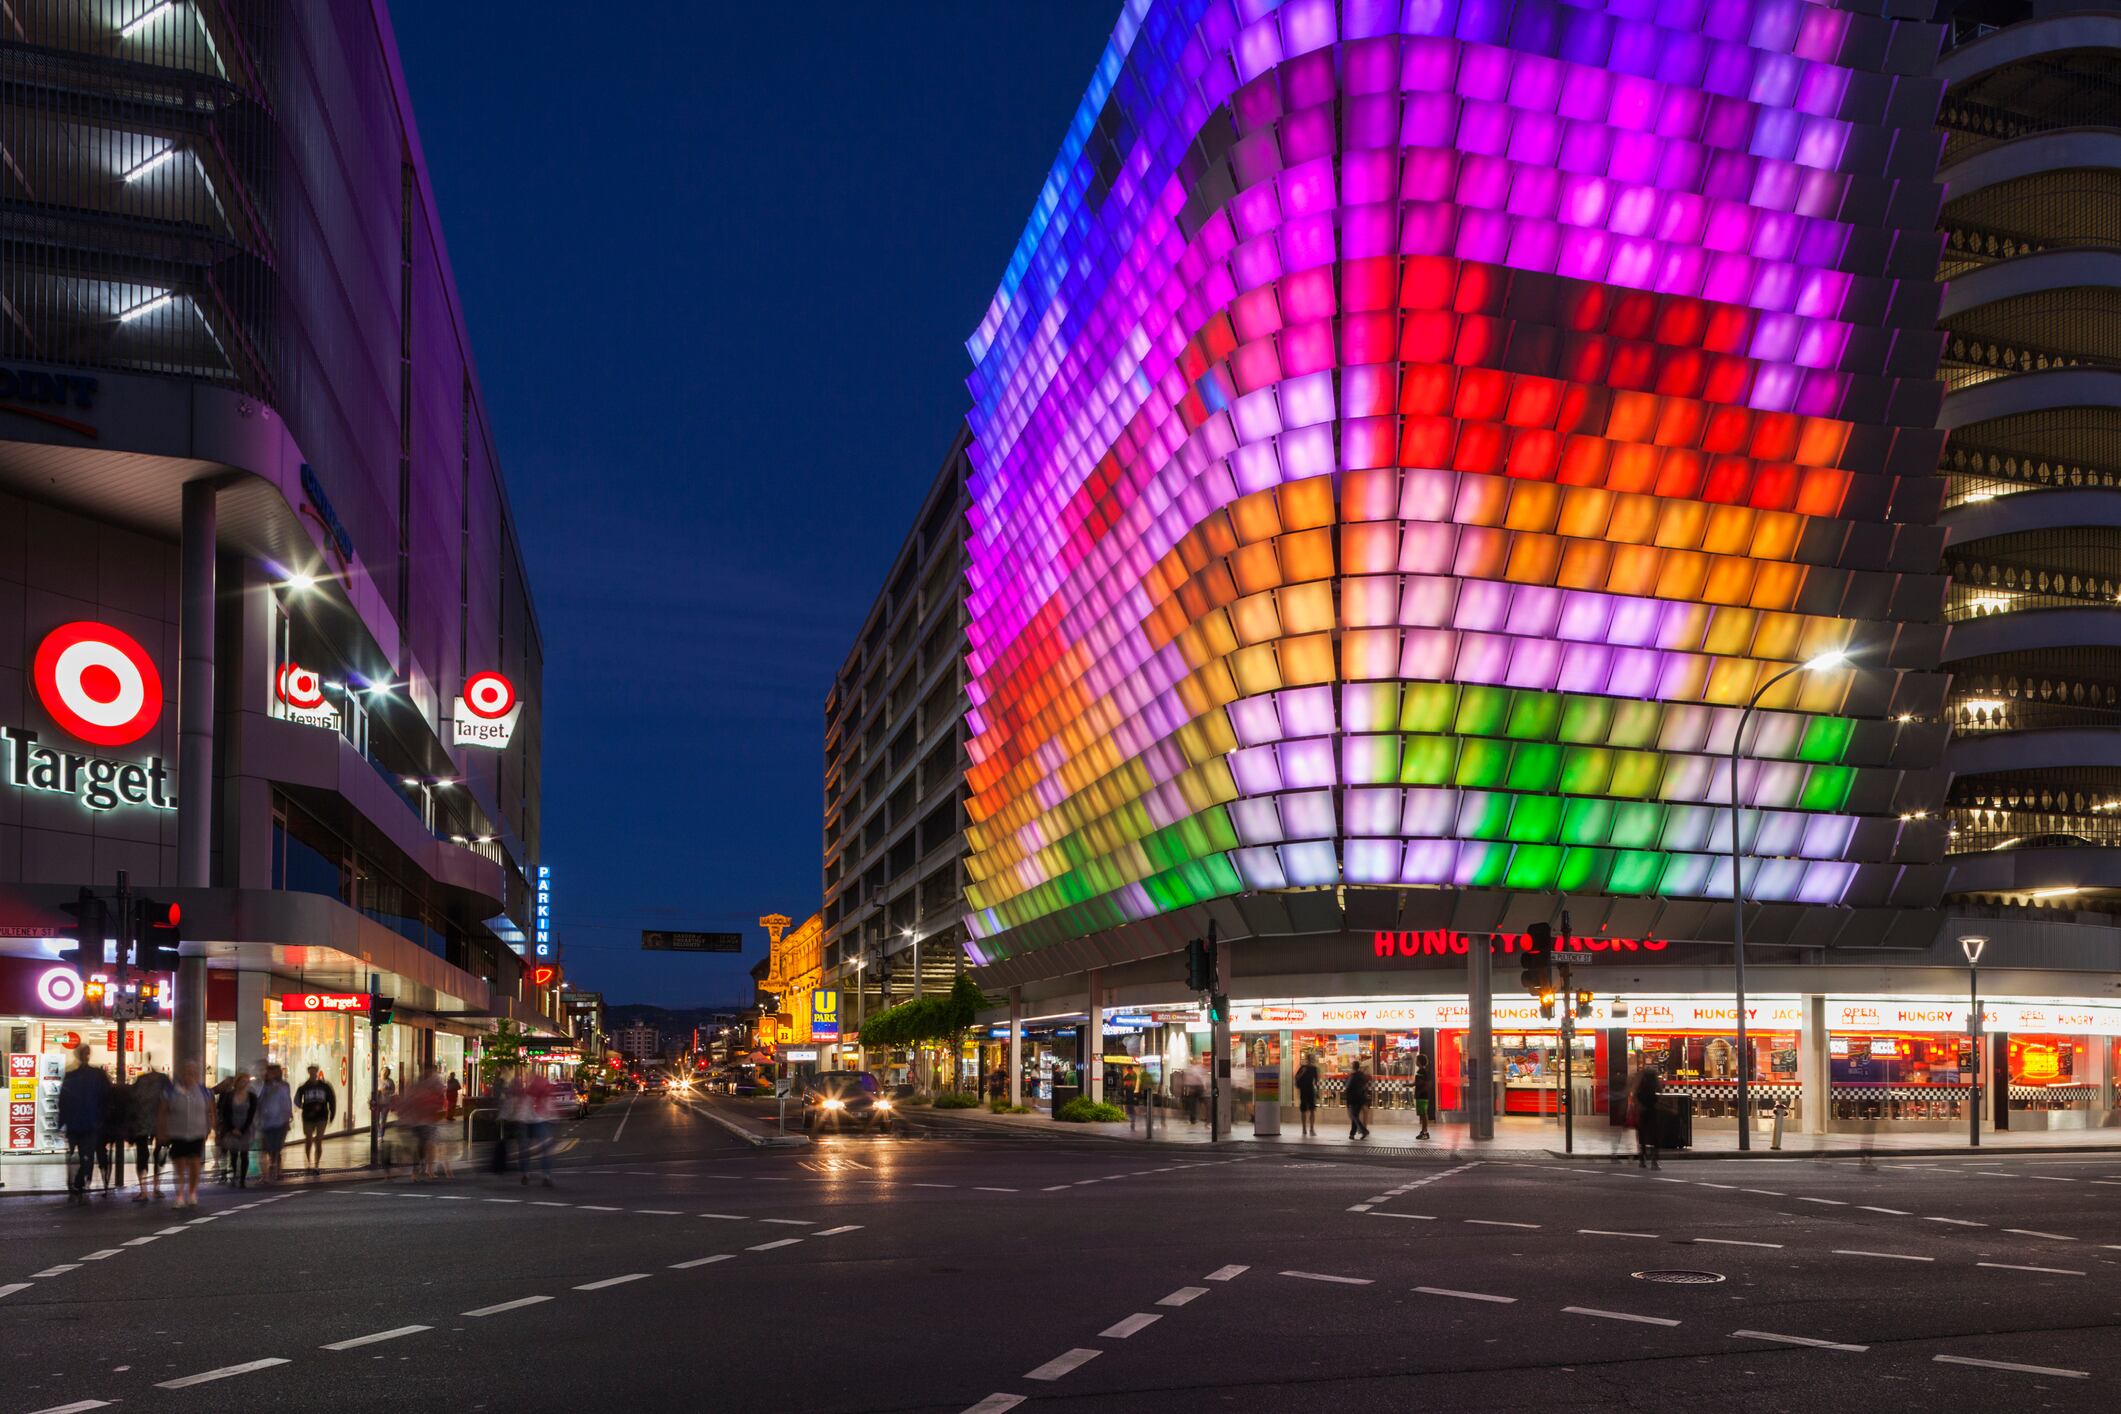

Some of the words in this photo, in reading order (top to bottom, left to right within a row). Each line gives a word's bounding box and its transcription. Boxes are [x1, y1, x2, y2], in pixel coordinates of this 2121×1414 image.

[455, 719, 509, 740] Target.
[0, 726, 178, 811] Target.
[536, 866, 549, 956] PARKING
[41, 927, 53, 937] ST
[1374, 927, 1517, 956] HUNGY
[321, 996, 361, 1010] Target.
[815, 991, 837, 1013] U
[813, 1013, 837, 1022] PARK
[1322, 1010, 1367, 1020] HUNGRY
[1376, 1008, 1415, 1019] JACKS
[1492, 1008, 1538, 1019] HUNGR
[1634, 1006, 1671, 1016] OPEN
[1843, 1007, 1877, 1017] OPEN
[1898, 1010, 1952, 1022] HUNGRY
[12, 1056, 34, 1069] 30%
[12, 1103, 34, 1116] 30%
